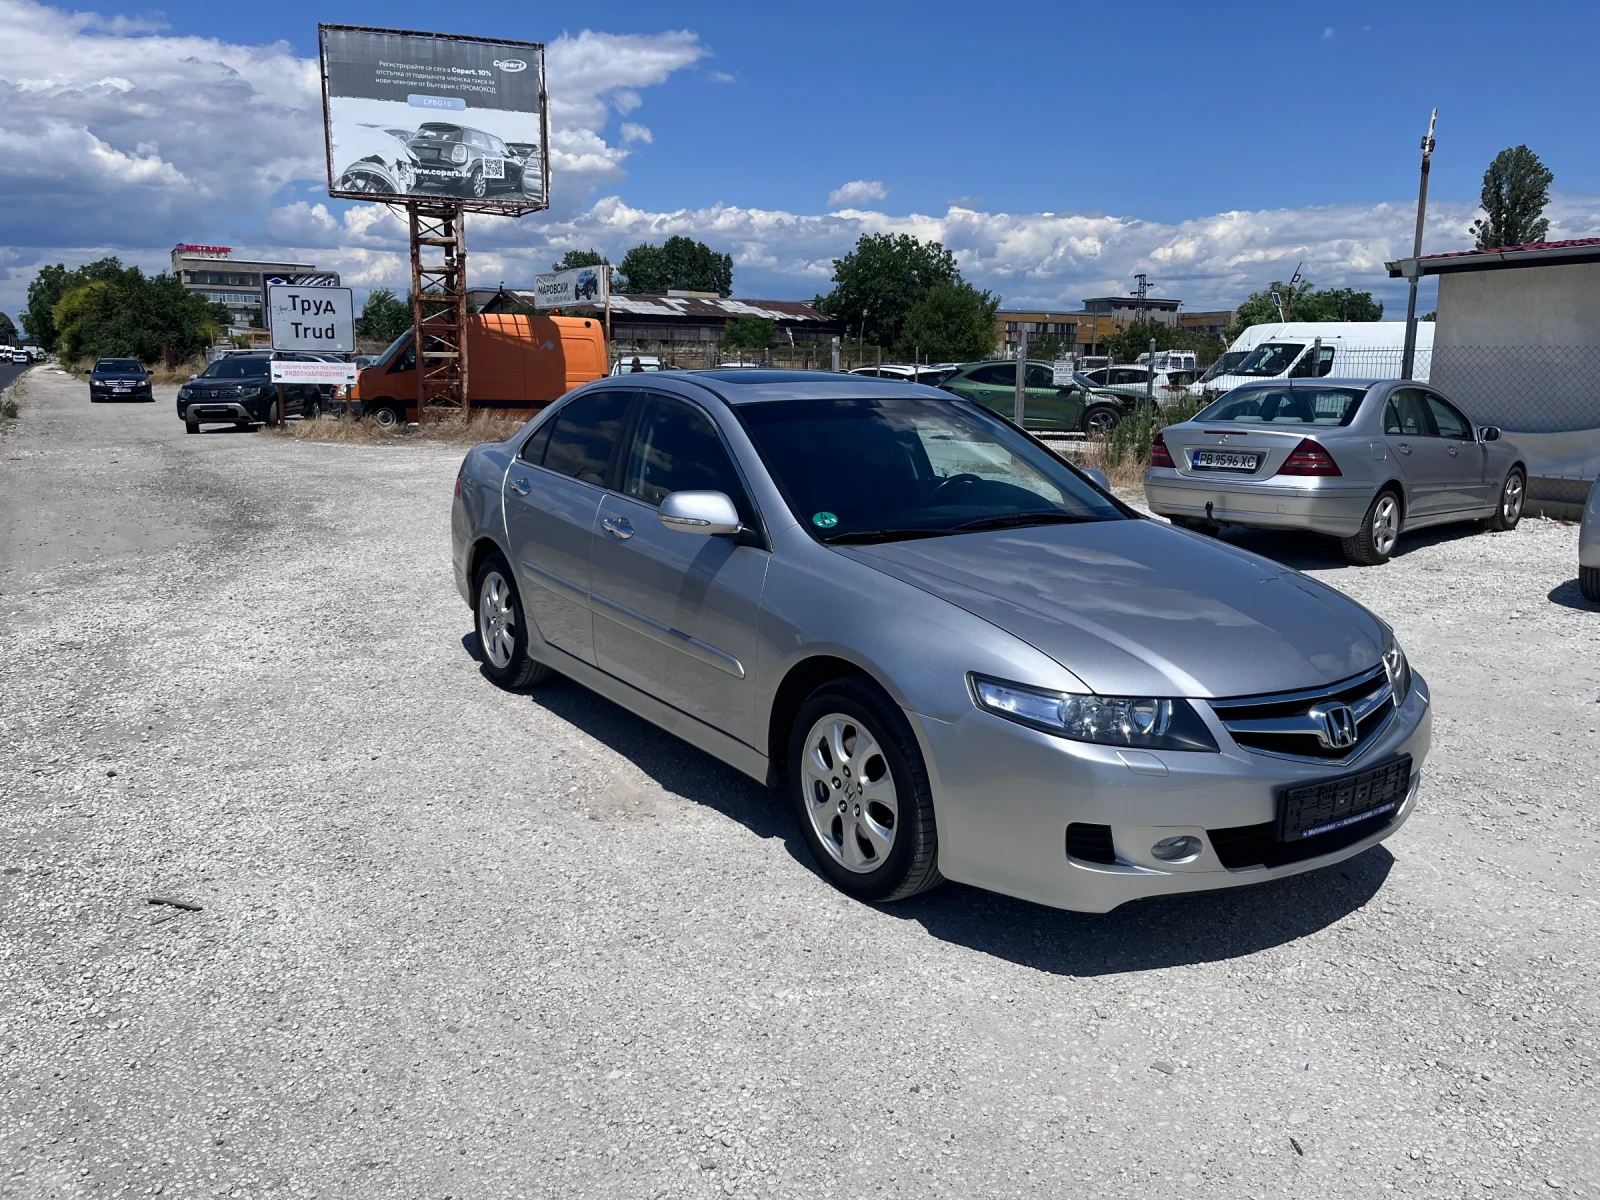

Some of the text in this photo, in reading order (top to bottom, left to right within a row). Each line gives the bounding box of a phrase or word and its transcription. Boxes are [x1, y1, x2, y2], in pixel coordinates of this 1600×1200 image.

[379, 60, 425, 71] Регистрирайте
[478, 69, 492, 77] 10%
[493, 60, 524, 70] Copart
[375, 69, 405, 77] отстъпка
[412, 73, 446, 81] годишната
[446, 75, 471, 83] членска
[392, 79, 418, 87] членове
[426, 81, 456, 90] България
[460, 84, 497, 94] ПРОМОКОД
[423, 98, 452, 107] CPBG10
[409, 166, 472, 178] www.copart.de
[538, 282, 569, 295] МАРОВСКИ
[287, 294, 336, 316] Труд
[290, 322, 335, 340] Trud
[1200, 454, 1255, 467] PB 9596 XC
